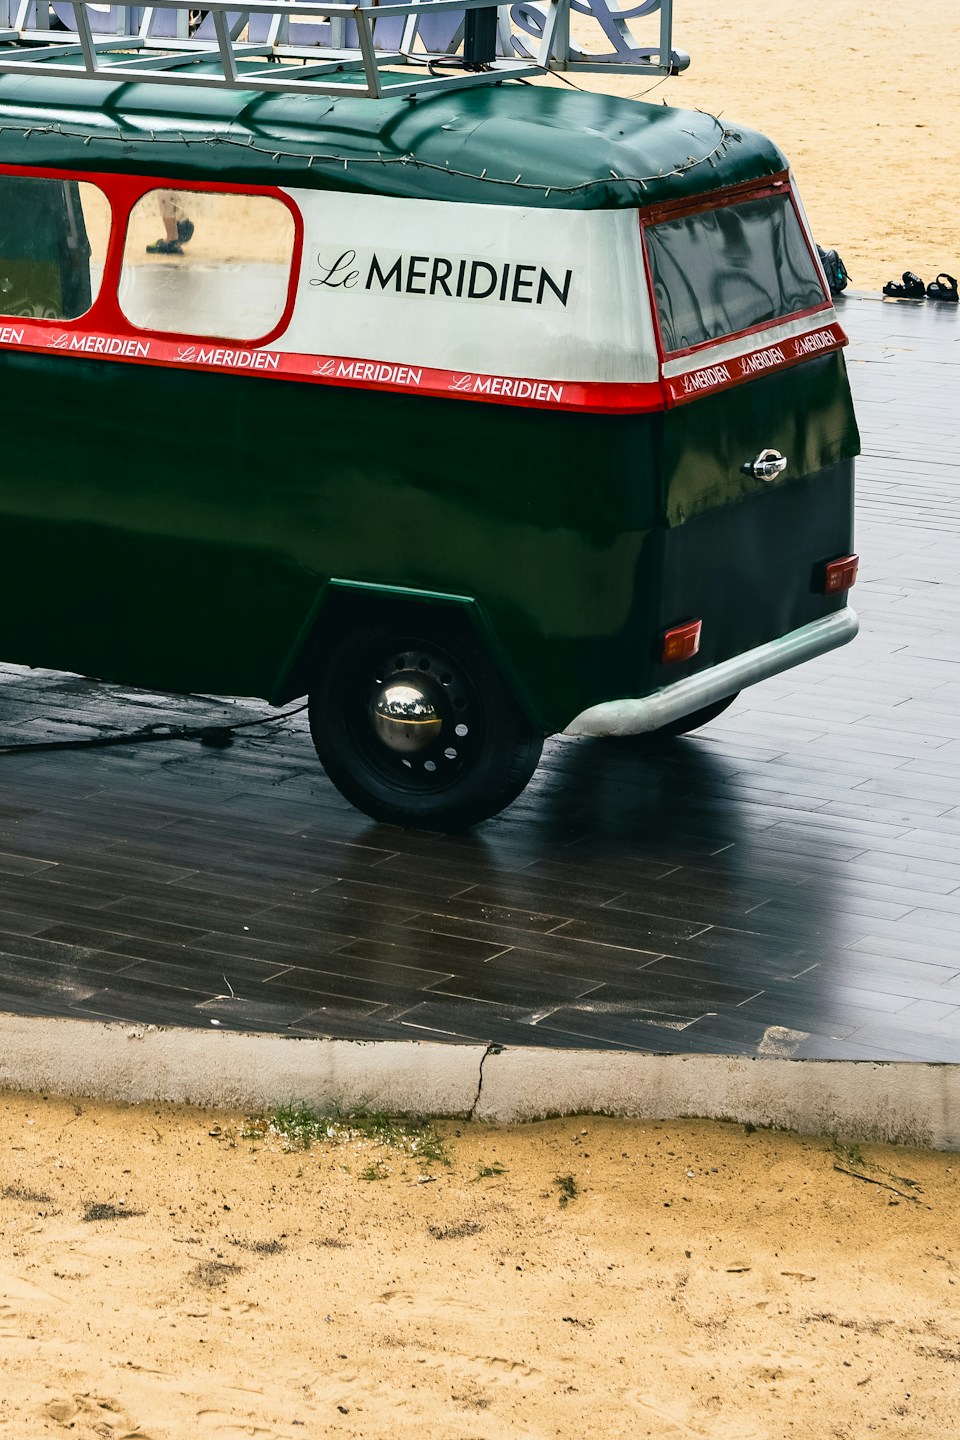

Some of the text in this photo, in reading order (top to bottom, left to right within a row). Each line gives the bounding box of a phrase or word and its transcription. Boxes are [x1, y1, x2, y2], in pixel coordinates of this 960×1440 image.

[309, 249, 572, 307] Le MERIDIEN
[46, 333, 150, 358] Le MERIDIEN
[801, 329, 837, 353] MERIDIEN
[173, 346, 280, 370] Le MERIDIEN
[748, 347, 786, 372] MERIDIEN
[312, 359, 422, 385] Le MERIDIEN
[691, 364, 731, 393] MERIDIEN
[448, 374, 563, 403] Le MERIDIEN
